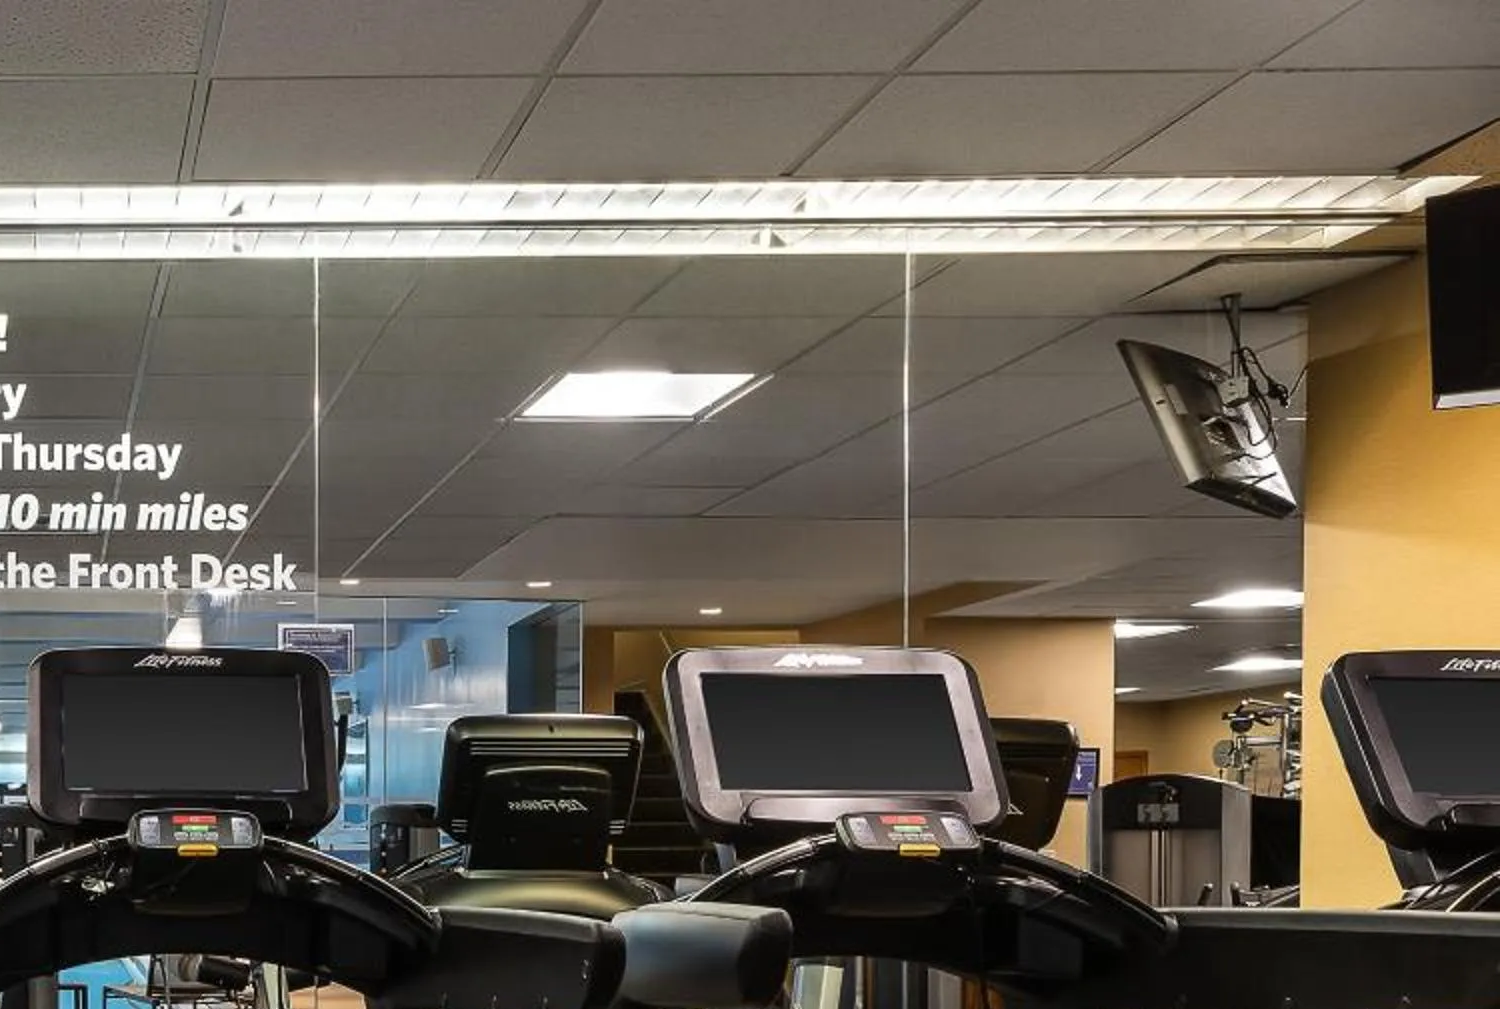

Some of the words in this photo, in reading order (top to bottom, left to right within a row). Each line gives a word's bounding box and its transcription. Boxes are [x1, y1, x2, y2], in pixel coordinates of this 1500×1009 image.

[50, 492, 126, 530] min
[137, 492, 248, 531] miles
[68, 553, 178, 589] Front
[191, 553, 297, 590] Desk
